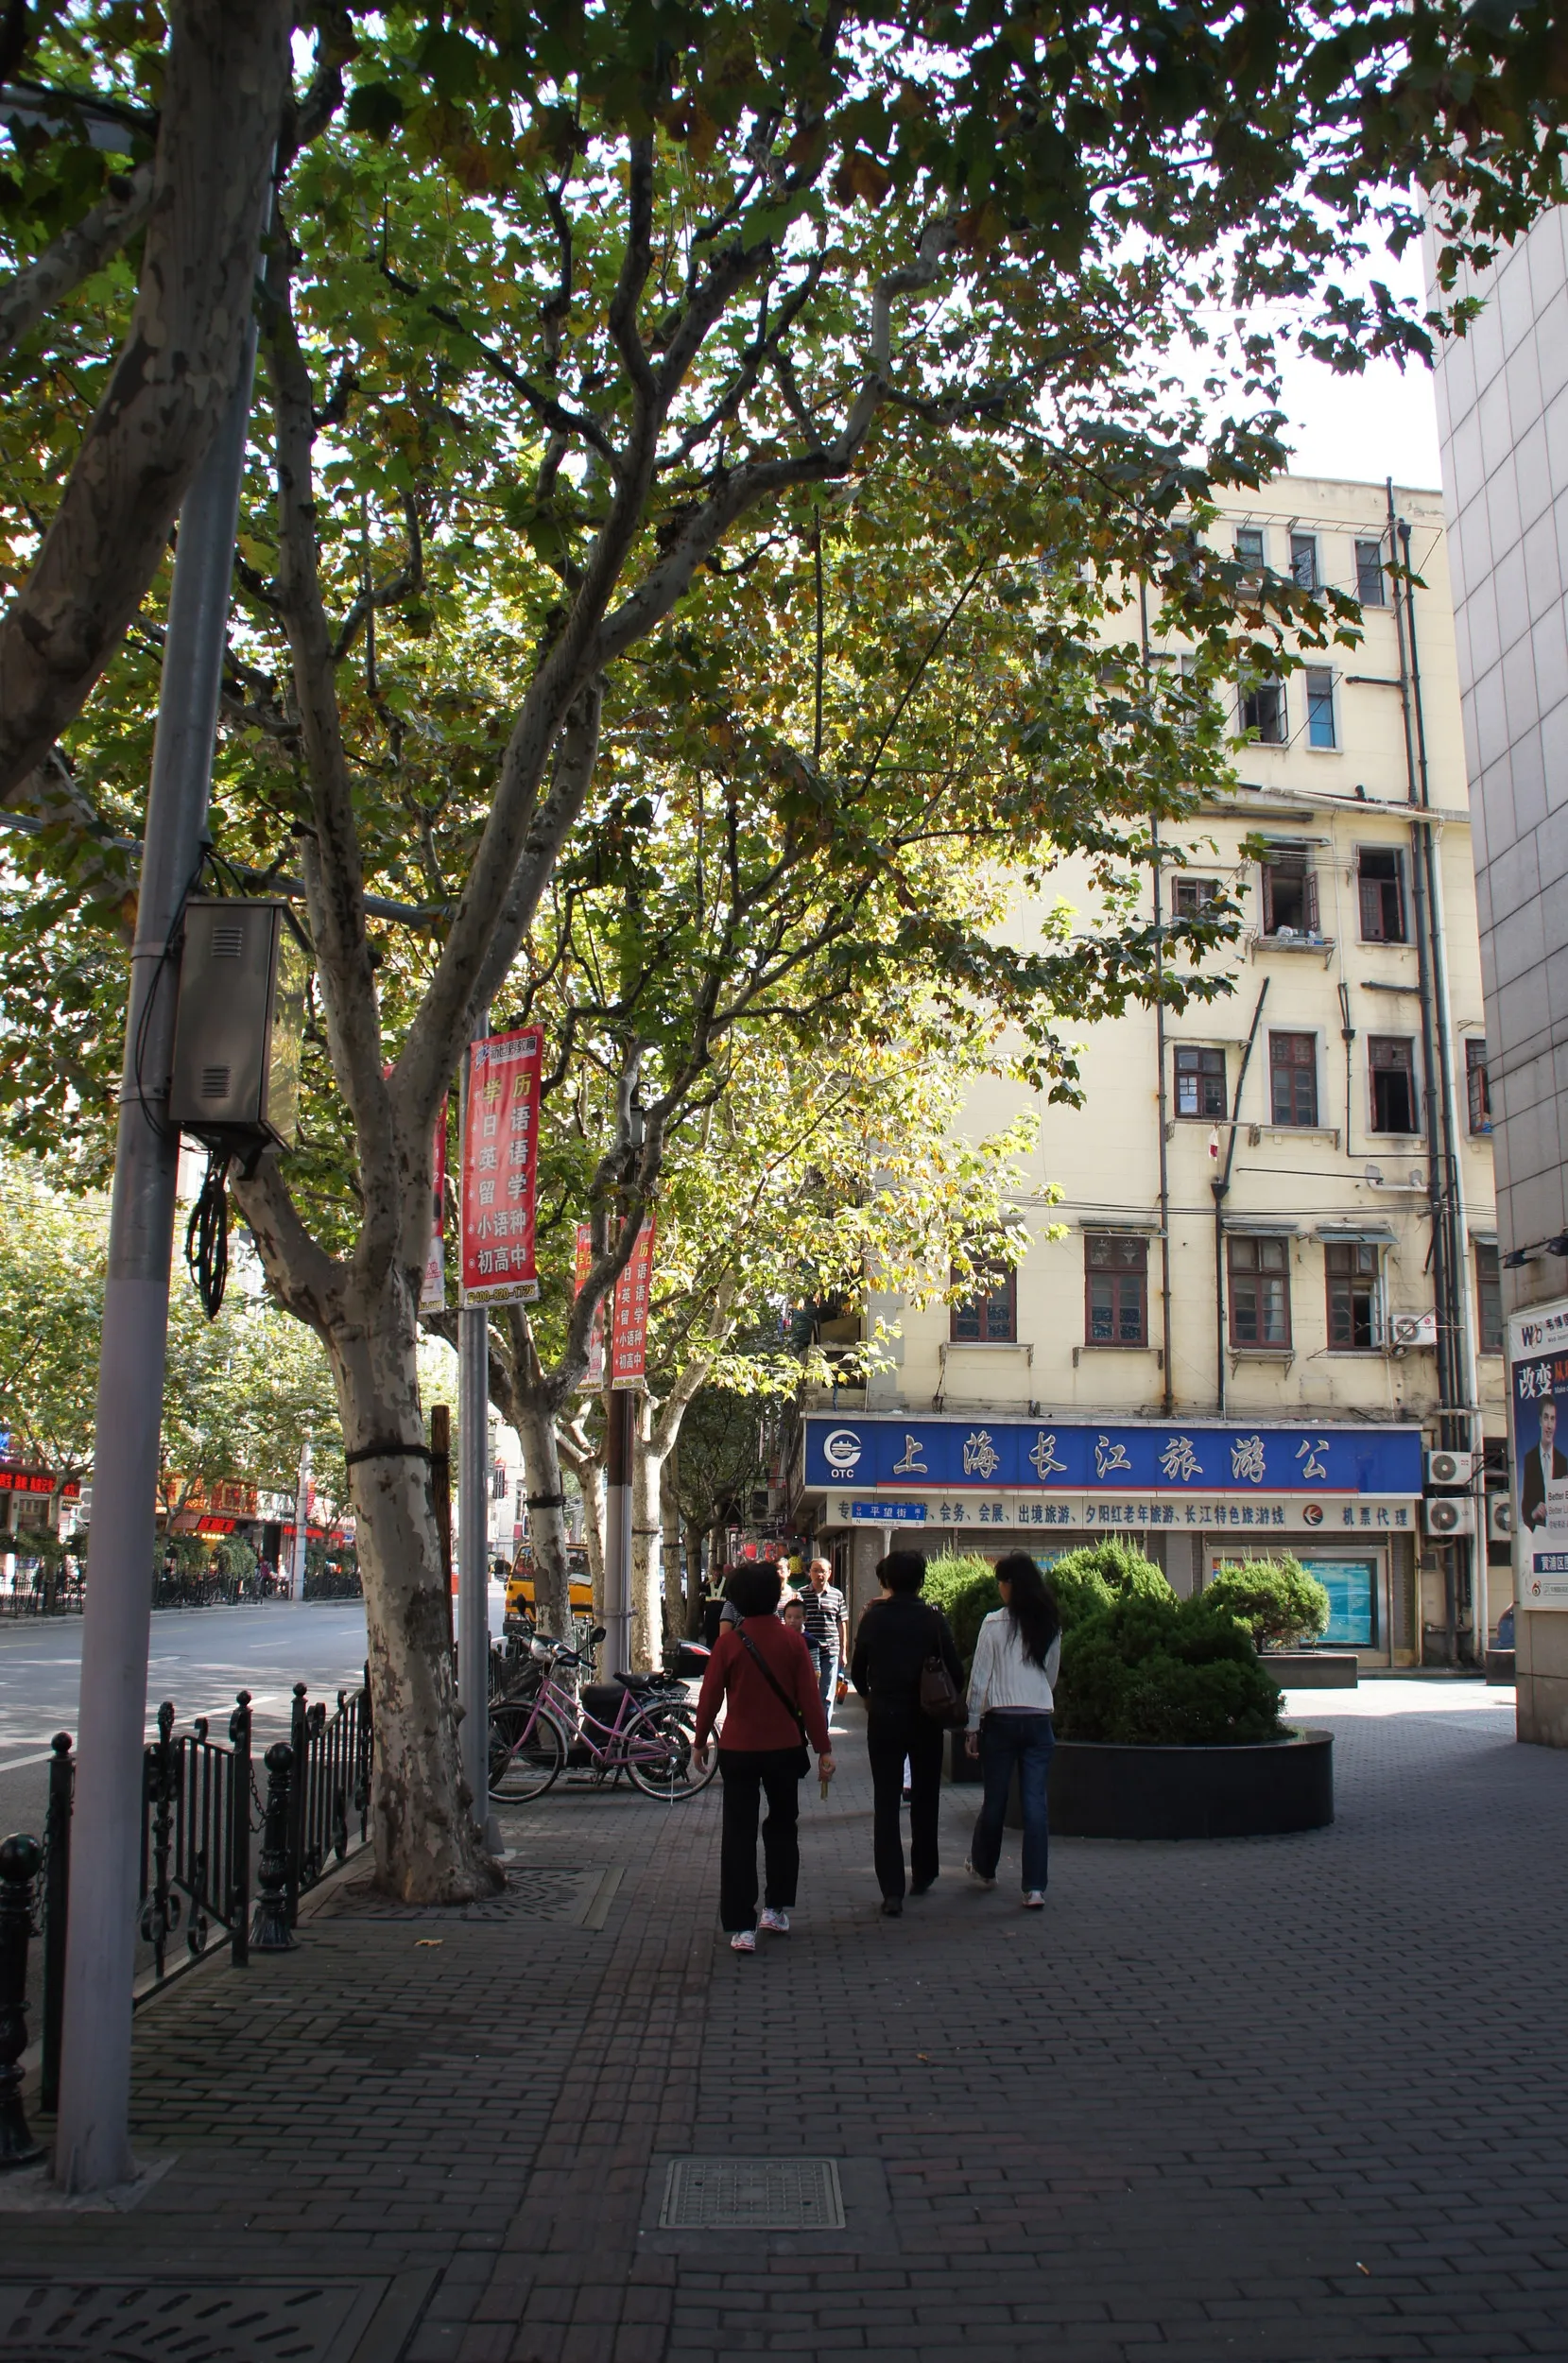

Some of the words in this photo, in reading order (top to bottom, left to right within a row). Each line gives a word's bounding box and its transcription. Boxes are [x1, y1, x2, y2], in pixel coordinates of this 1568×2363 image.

[482, 1073, 532, 1104] 学历
[483, 1105, 531, 1138] 日语
[479, 1139, 529, 1171] 英语
[478, 1173, 527, 1206] 留学
[476, 1208, 526, 1240] 小语种
[477, 1243, 526, 1275] 初高中
[623, 1263, 648, 1282] 日语
[475, 1285, 536, 1302] 400-820-1728
[621, 1285, 646, 1304] 英语
[619, 1307, 645, 1326] 留学
[619, 1330, 644, 1348] 小语种
[619, 1351, 642, 1370] 初高中
[1518, 1362, 1552, 1400] 改变
[893, 1429, 1329, 1483] 上海长江旅游公
[831, 1469, 854, 1478] OTC
[870, 1506, 906, 1518] 平望街
[1342, 1507, 1408, 1526] 机票代理
